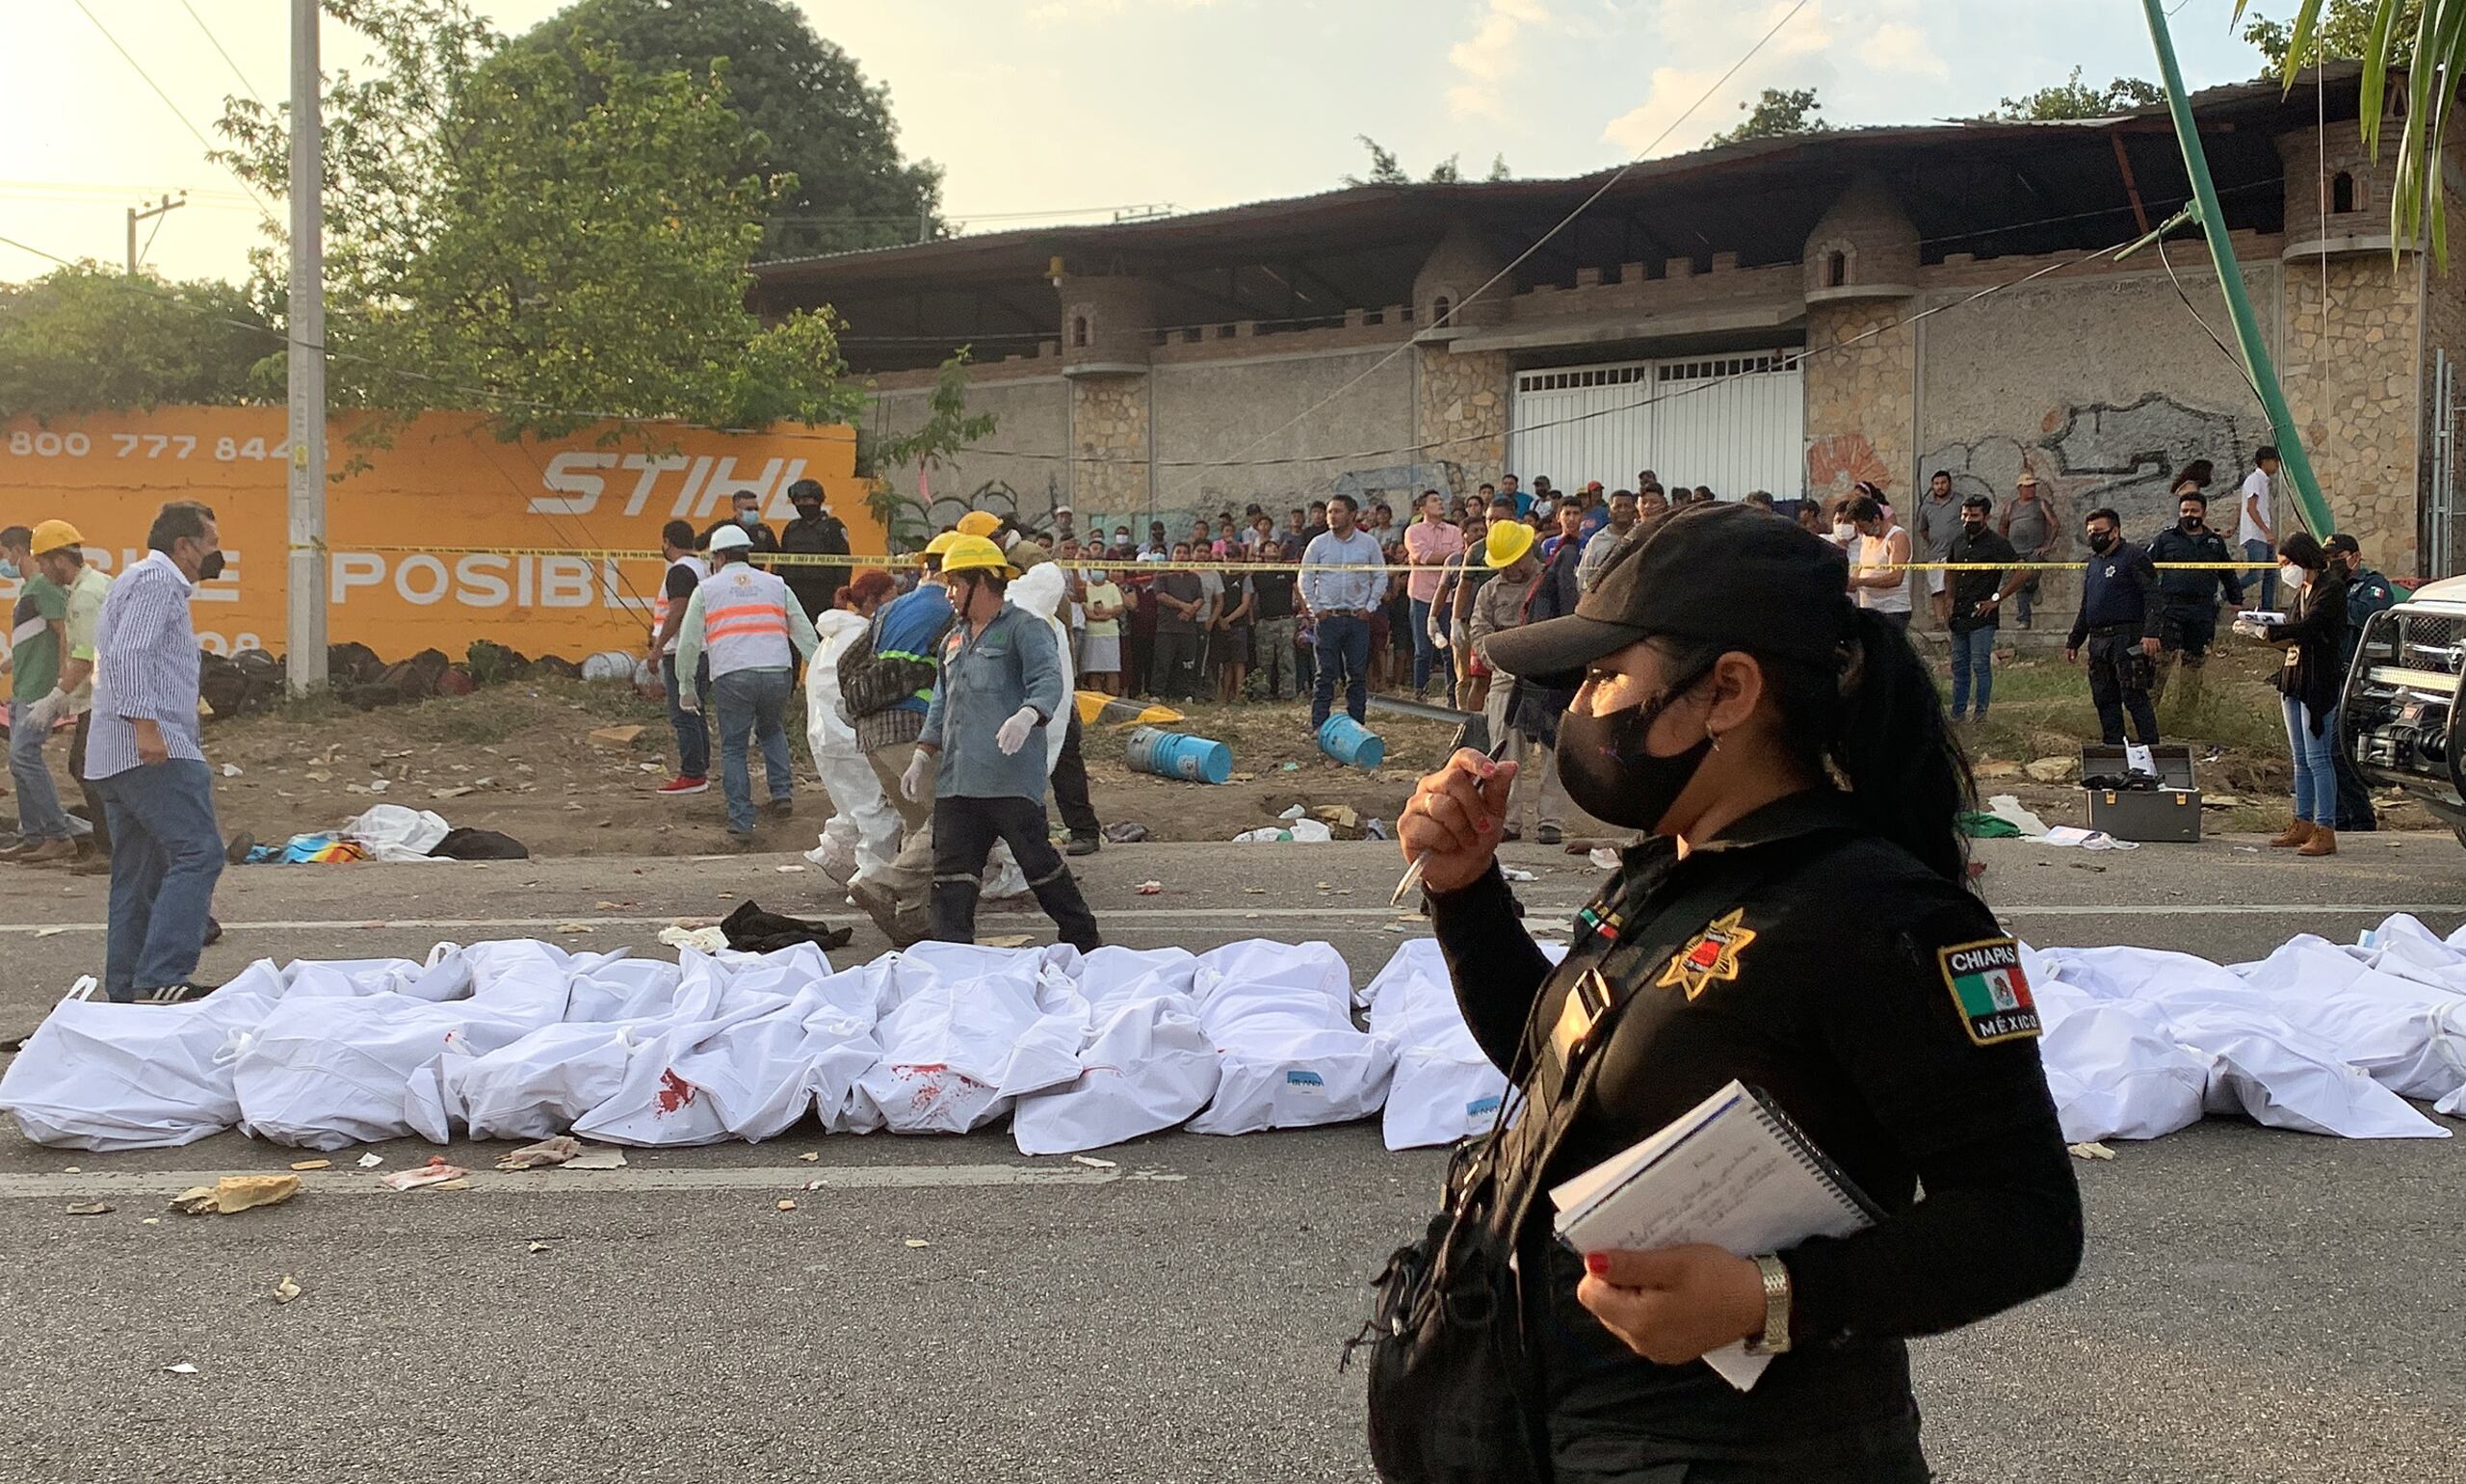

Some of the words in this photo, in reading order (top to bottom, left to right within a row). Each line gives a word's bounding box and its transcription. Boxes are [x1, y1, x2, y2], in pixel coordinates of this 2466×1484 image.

[9, 430, 92, 456] 800
[112, 433, 197, 458] 777
[527, 452, 832, 520] STIHL
[331, 551, 667, 609] POSIBL
